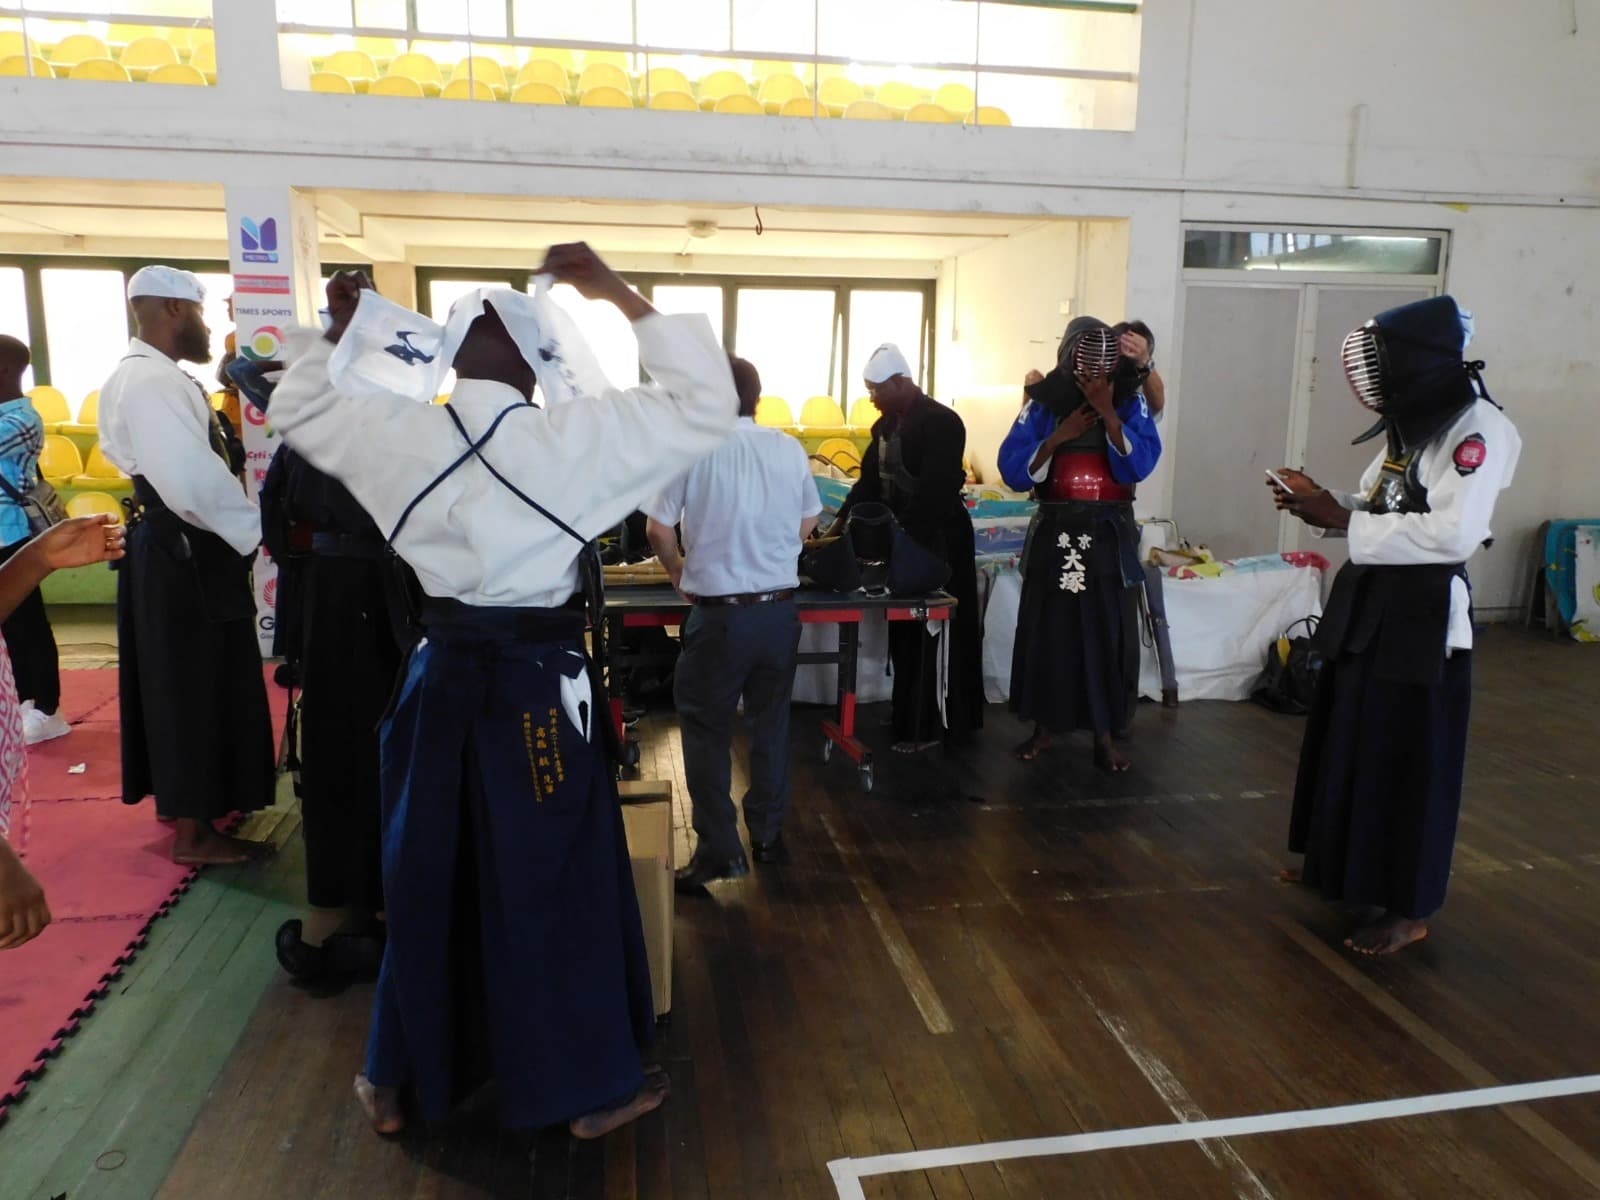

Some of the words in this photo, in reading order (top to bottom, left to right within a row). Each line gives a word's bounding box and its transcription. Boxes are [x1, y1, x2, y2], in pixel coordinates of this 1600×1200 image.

[236, 307, 259, 316] TIMES
[262, 308, 292, 317] SPORTS
[1057, 532, 1092, 550] 東京
[1059, 549, 1086, 594] 大塚
